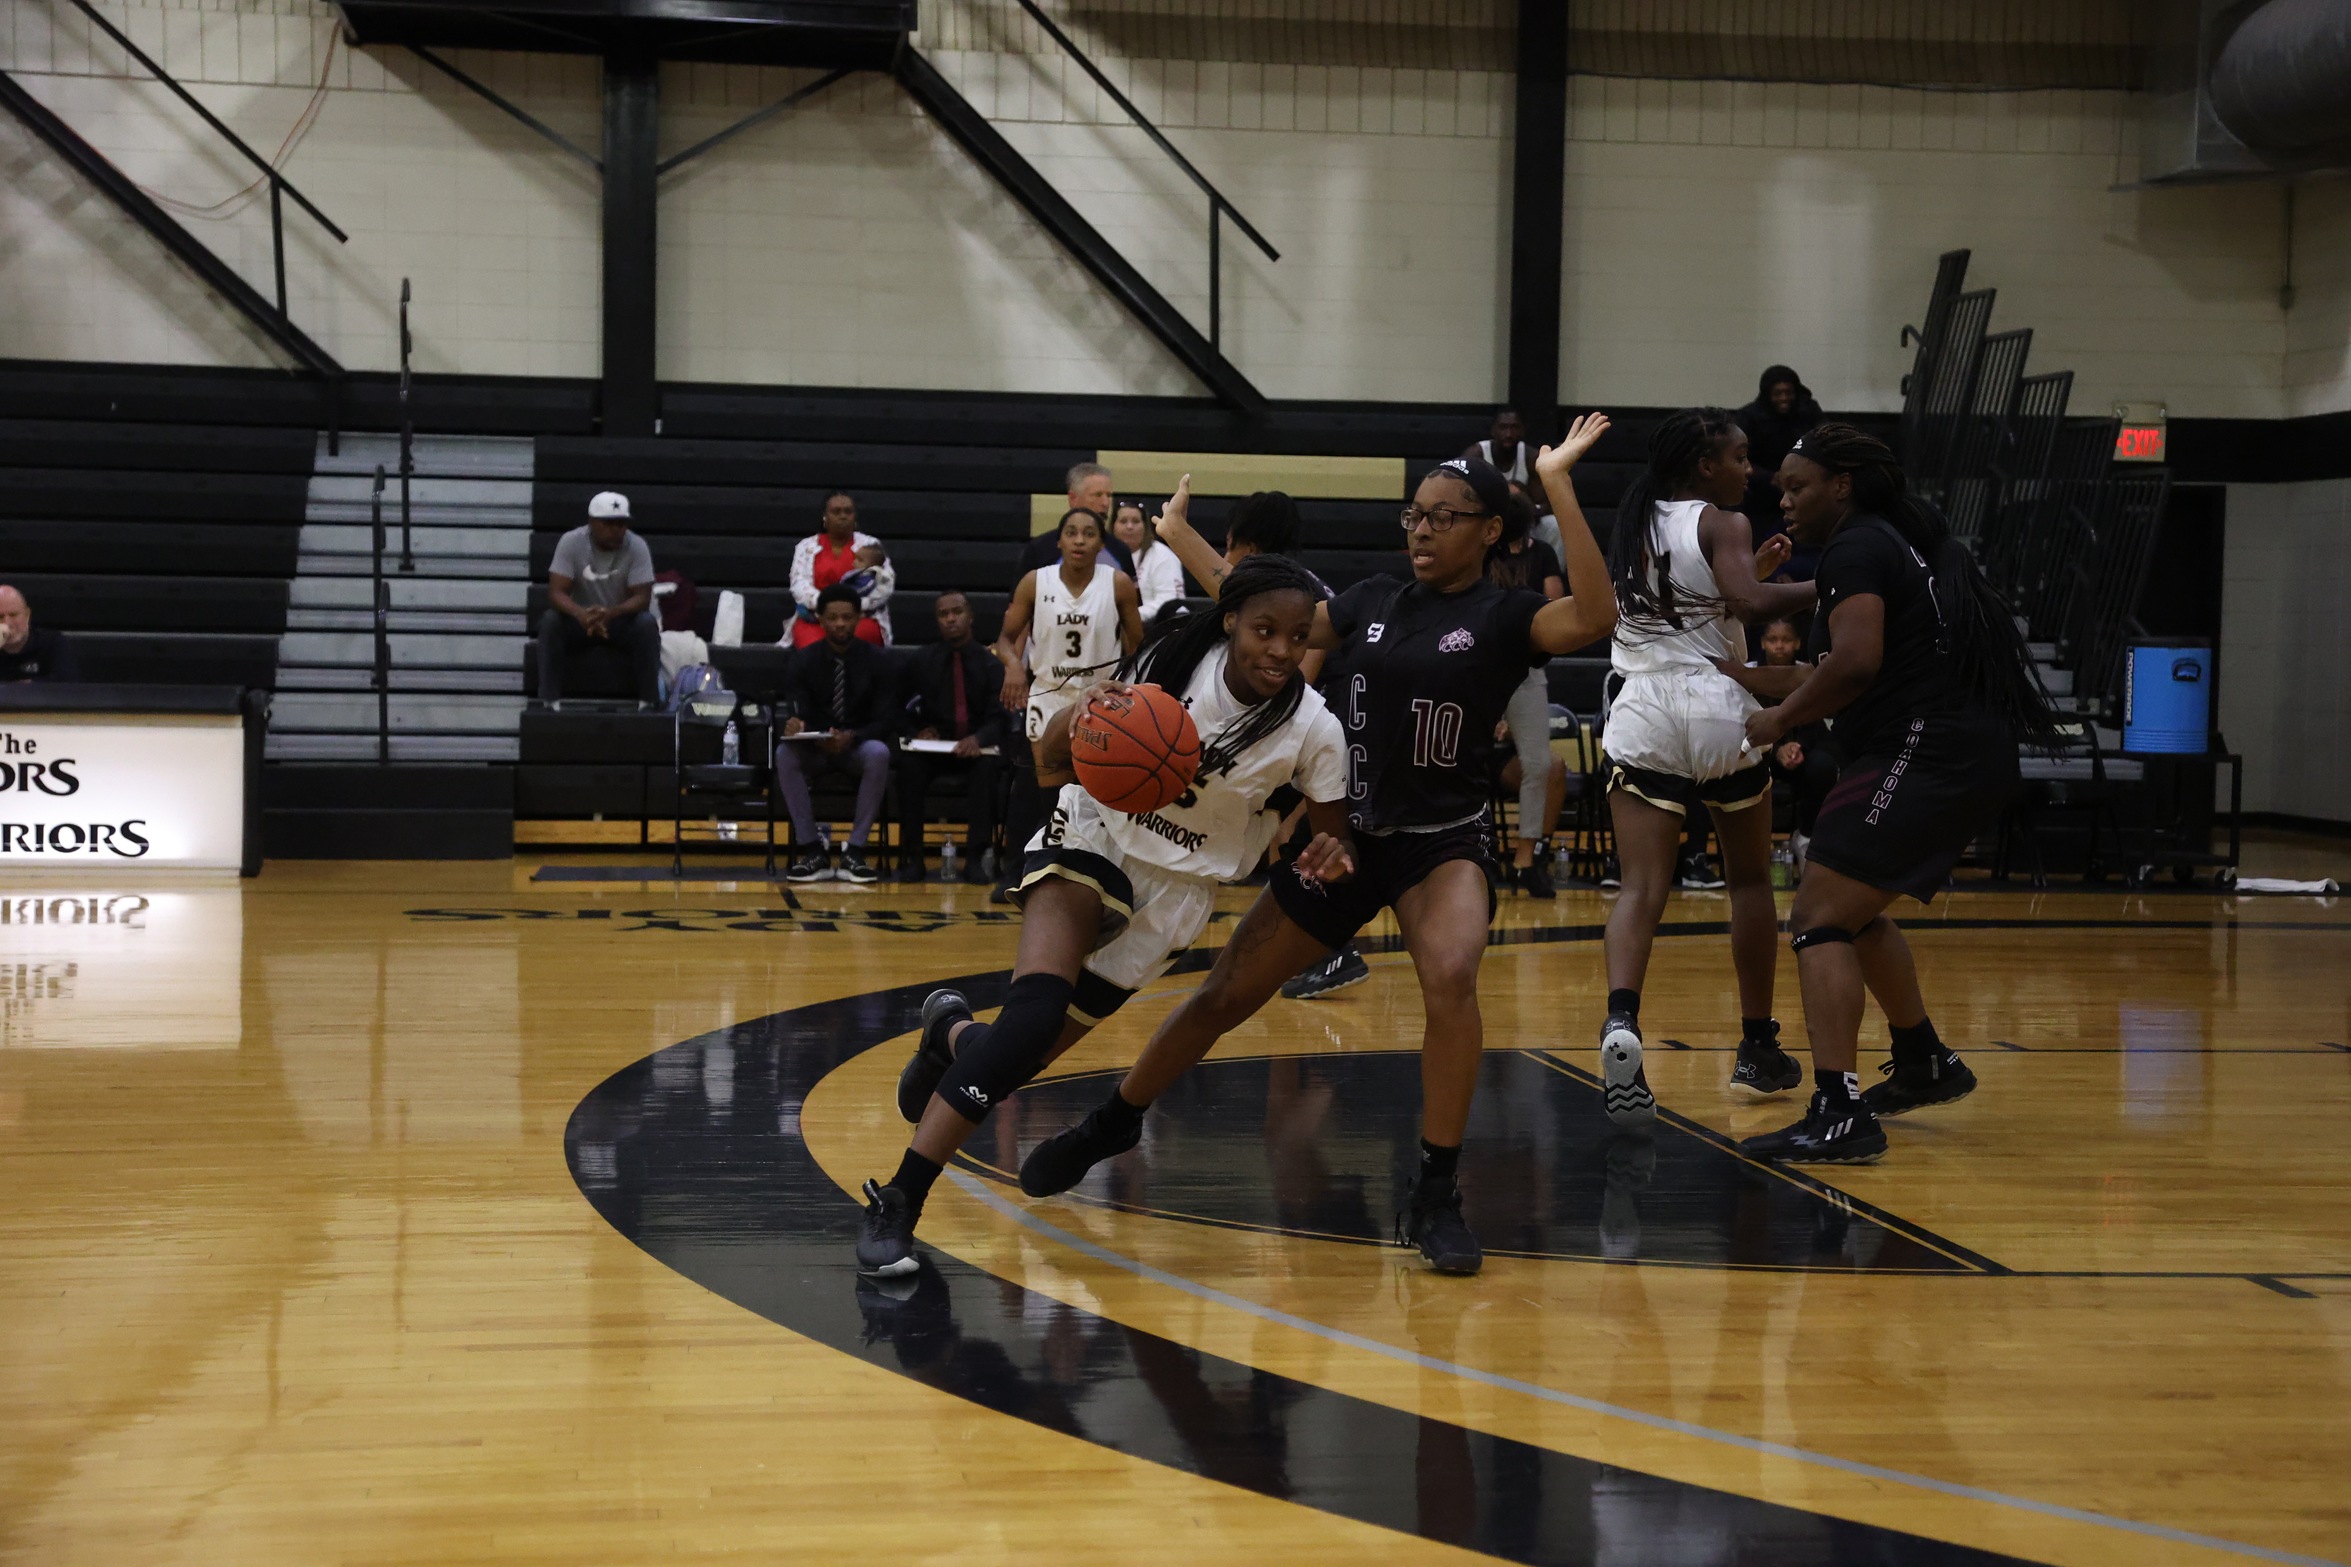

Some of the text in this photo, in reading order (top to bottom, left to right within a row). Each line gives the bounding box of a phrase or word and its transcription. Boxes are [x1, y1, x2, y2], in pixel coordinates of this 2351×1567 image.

[2122, 428, 2160, 457] EXIT
[1056, 613, 1089, 626] LADY
[1066, 631, 1081, 658] 3
[0, 733, 37, 754] he
[1411, 698, 1463, 768] 10
[1865, 717, 1924, 825] COAHOMA
[2, 820, 150, 857] RIORS
